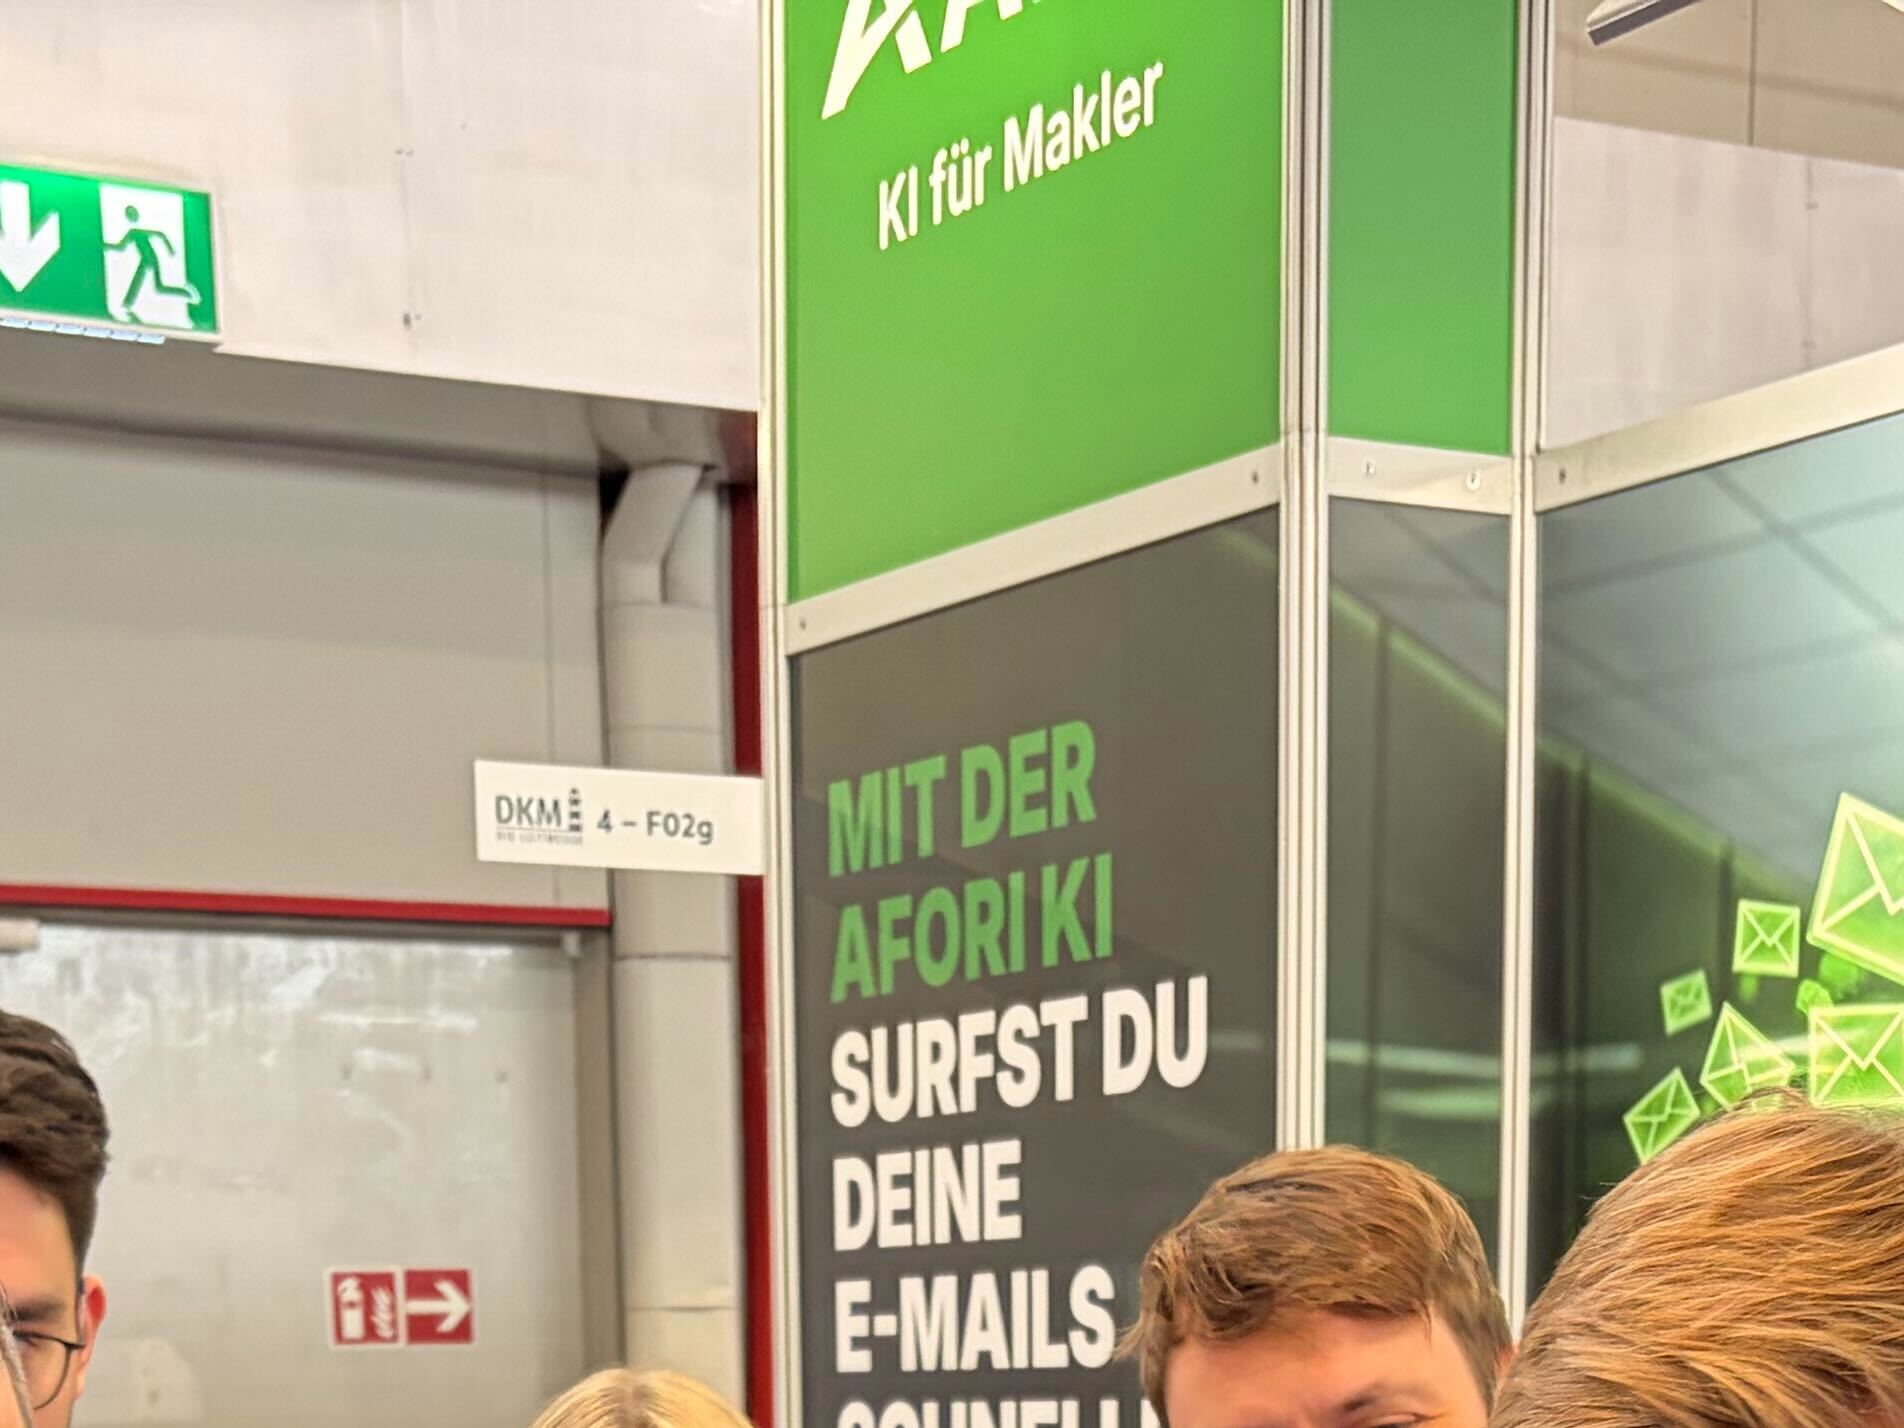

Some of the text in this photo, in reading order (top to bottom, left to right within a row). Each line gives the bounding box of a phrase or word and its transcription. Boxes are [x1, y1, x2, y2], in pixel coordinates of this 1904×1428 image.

[878, 61, 1164, 251] KI für Makler
[495, 795, 562, 827] DKM
[597, 809, 614, 833] 4
[646, 810, 714, 845] F02g
[827, 719, 1096, 878] MIT DER
[829, 852, 1113, 1003] AFORI KI
[830, 974, 1209, 1129] SURFST DU
[833, 1138, 1023, 1253] DEINE
[835, 1266, 1116, 1374] E-MAILS
